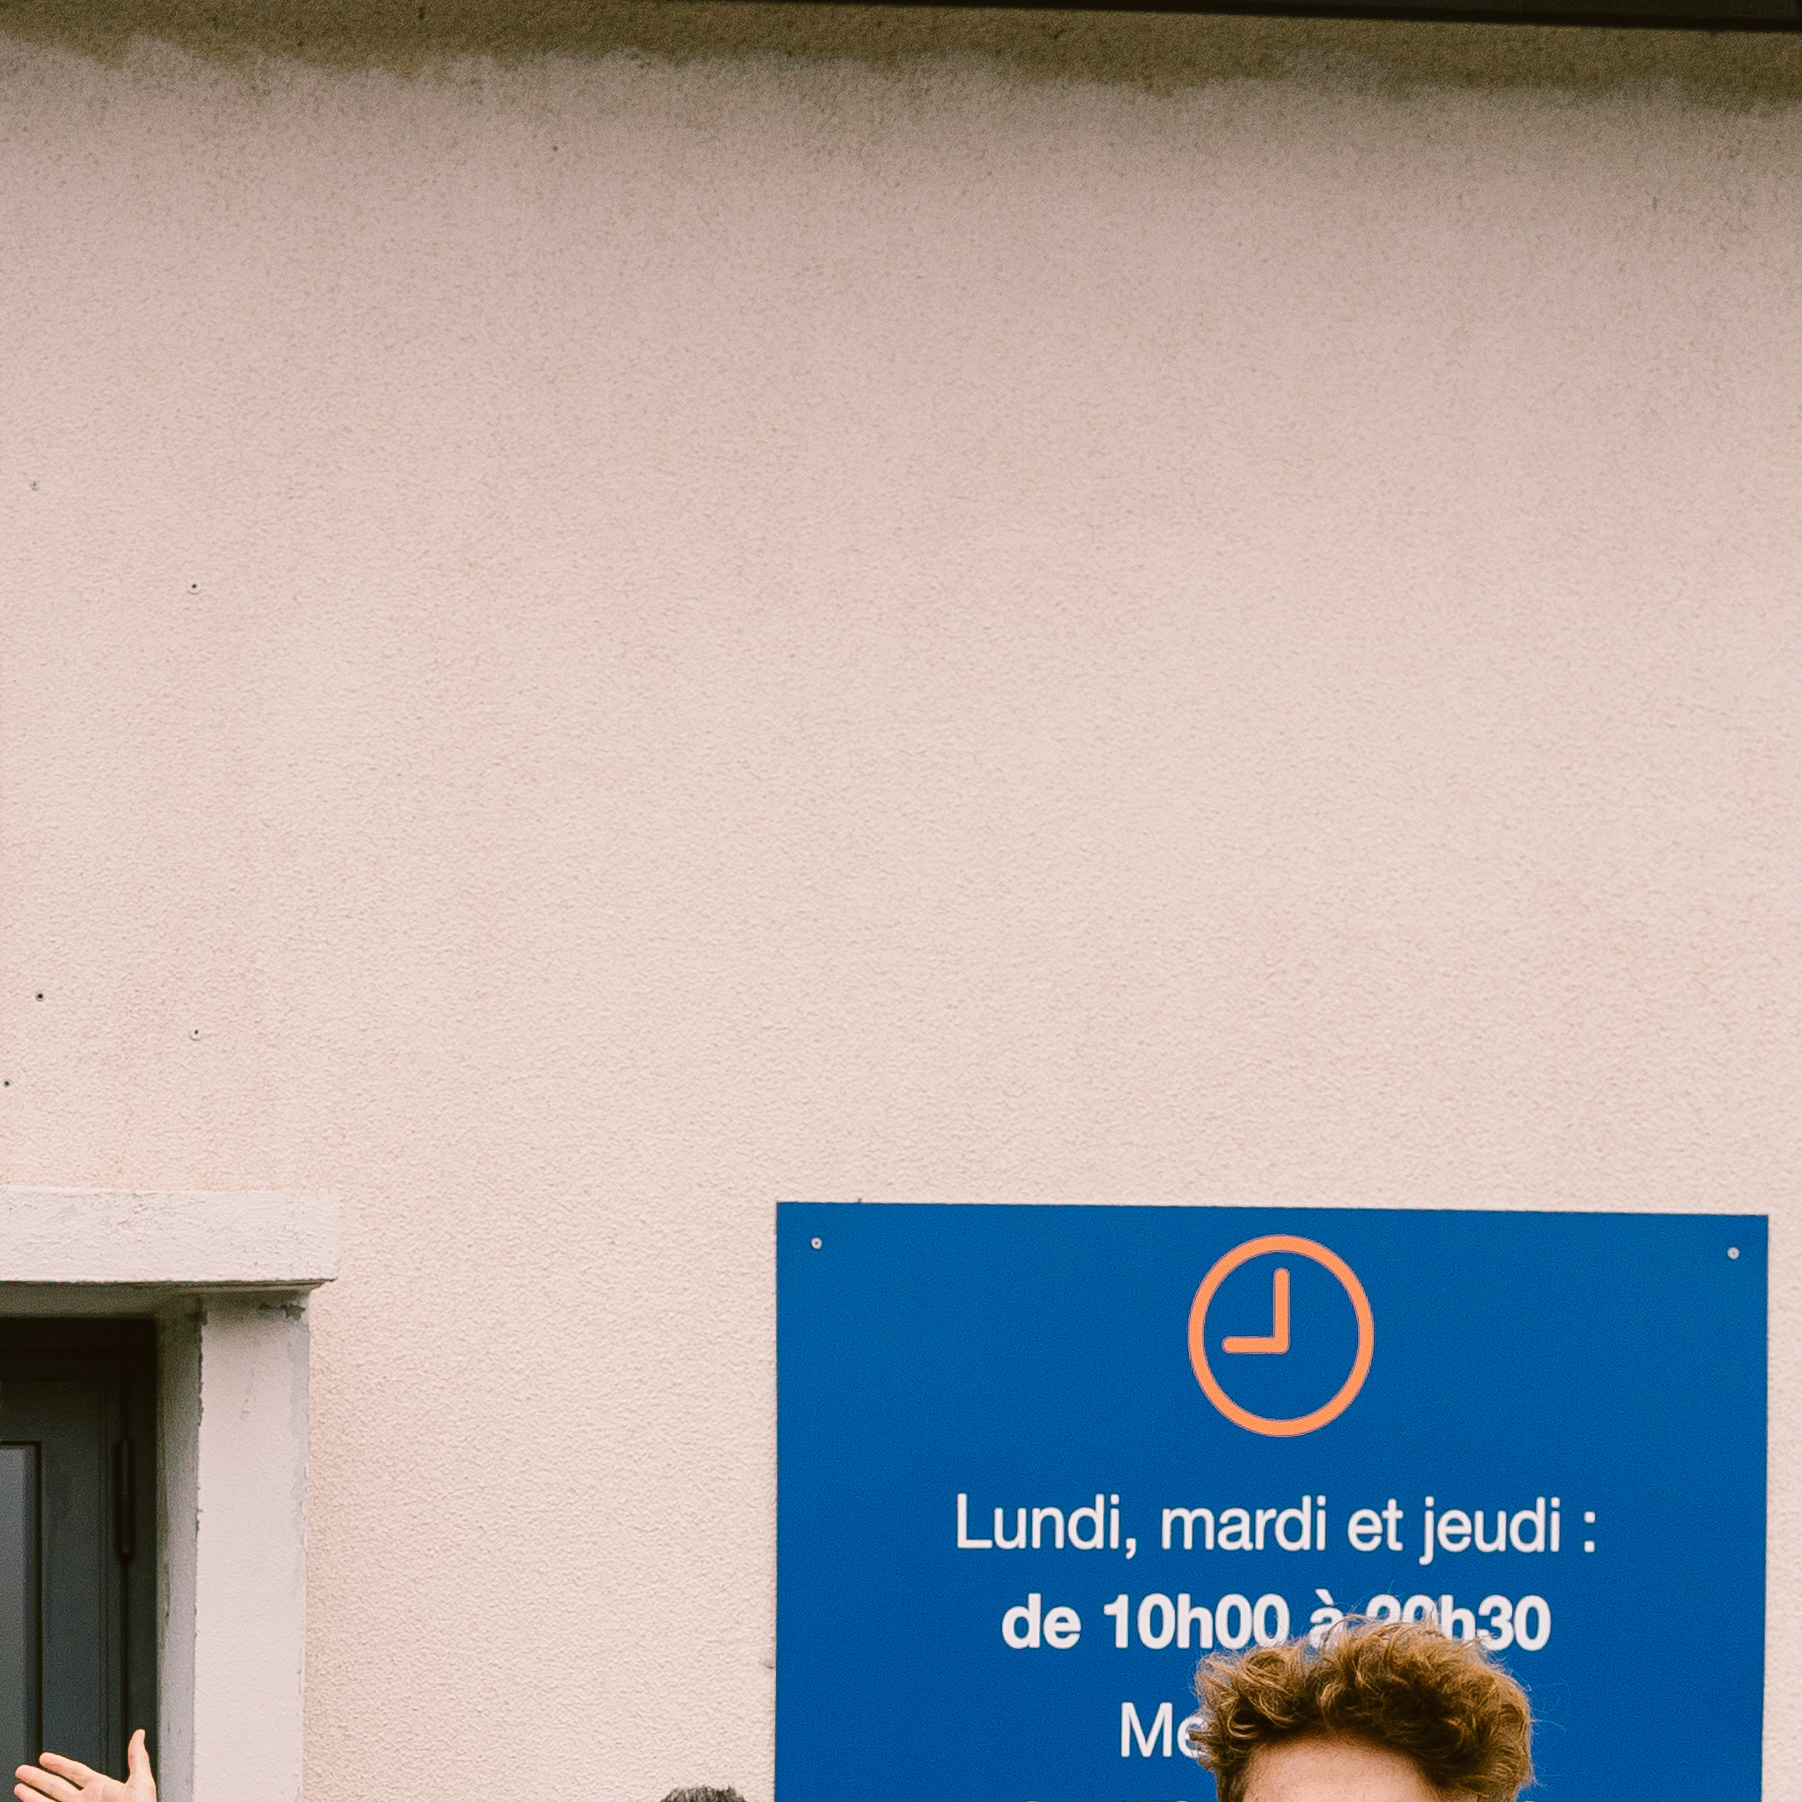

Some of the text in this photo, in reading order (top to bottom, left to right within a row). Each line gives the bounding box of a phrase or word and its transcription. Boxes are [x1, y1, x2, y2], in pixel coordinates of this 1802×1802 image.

[956, 1492, 1595, 1566] Lundi, mardi et jeudi :
[1001, 1592, 1082, 1650] de
[1103, 1592, 1291, 1650] 10h00
[1309, 1588, 1346, 1651] à
